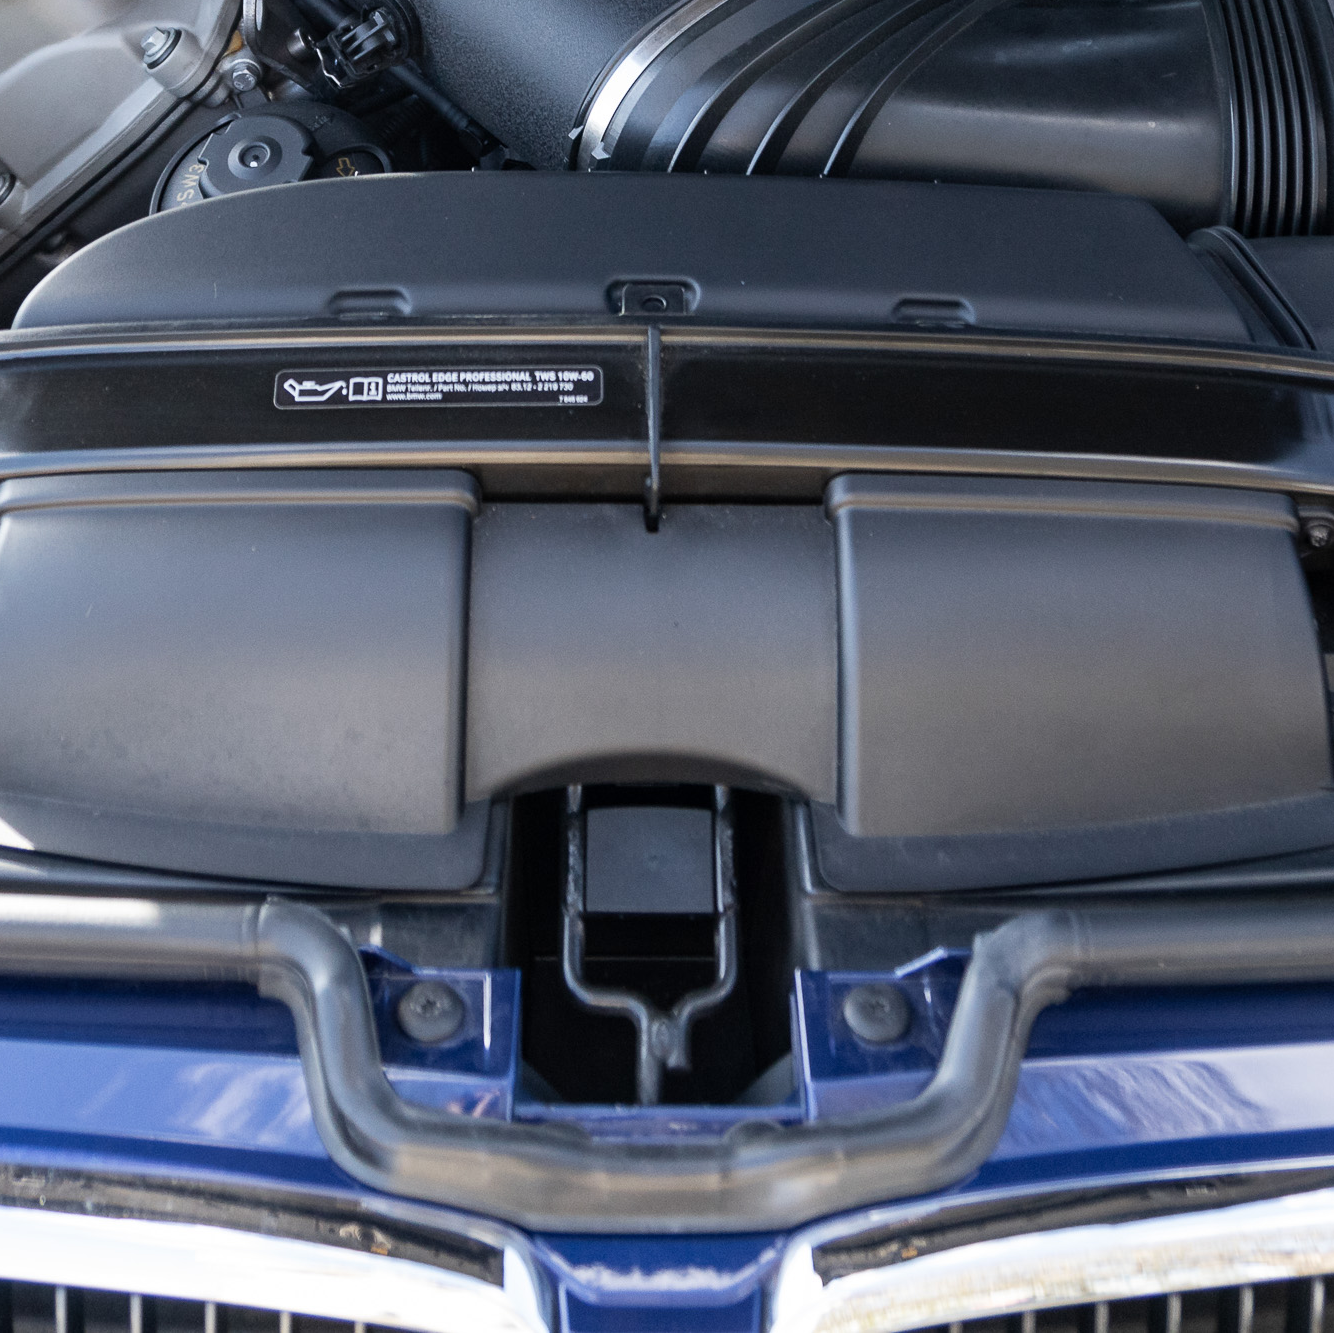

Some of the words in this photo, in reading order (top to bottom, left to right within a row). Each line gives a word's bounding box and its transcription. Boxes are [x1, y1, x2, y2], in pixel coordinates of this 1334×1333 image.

[387, 372, 431, 383] CASTROL
[432, 371, 458, 382] EDGE
[460, 371, 531, 382] PROFESSIONAL
[534, 370, 556, 381] TWS
[557, 370, 594, 382] 10W-60
[387, 384, 406, 392] BMW
[438, 383, 453, 392] Part
[386, 392, 442, 400] www.bmw.com
